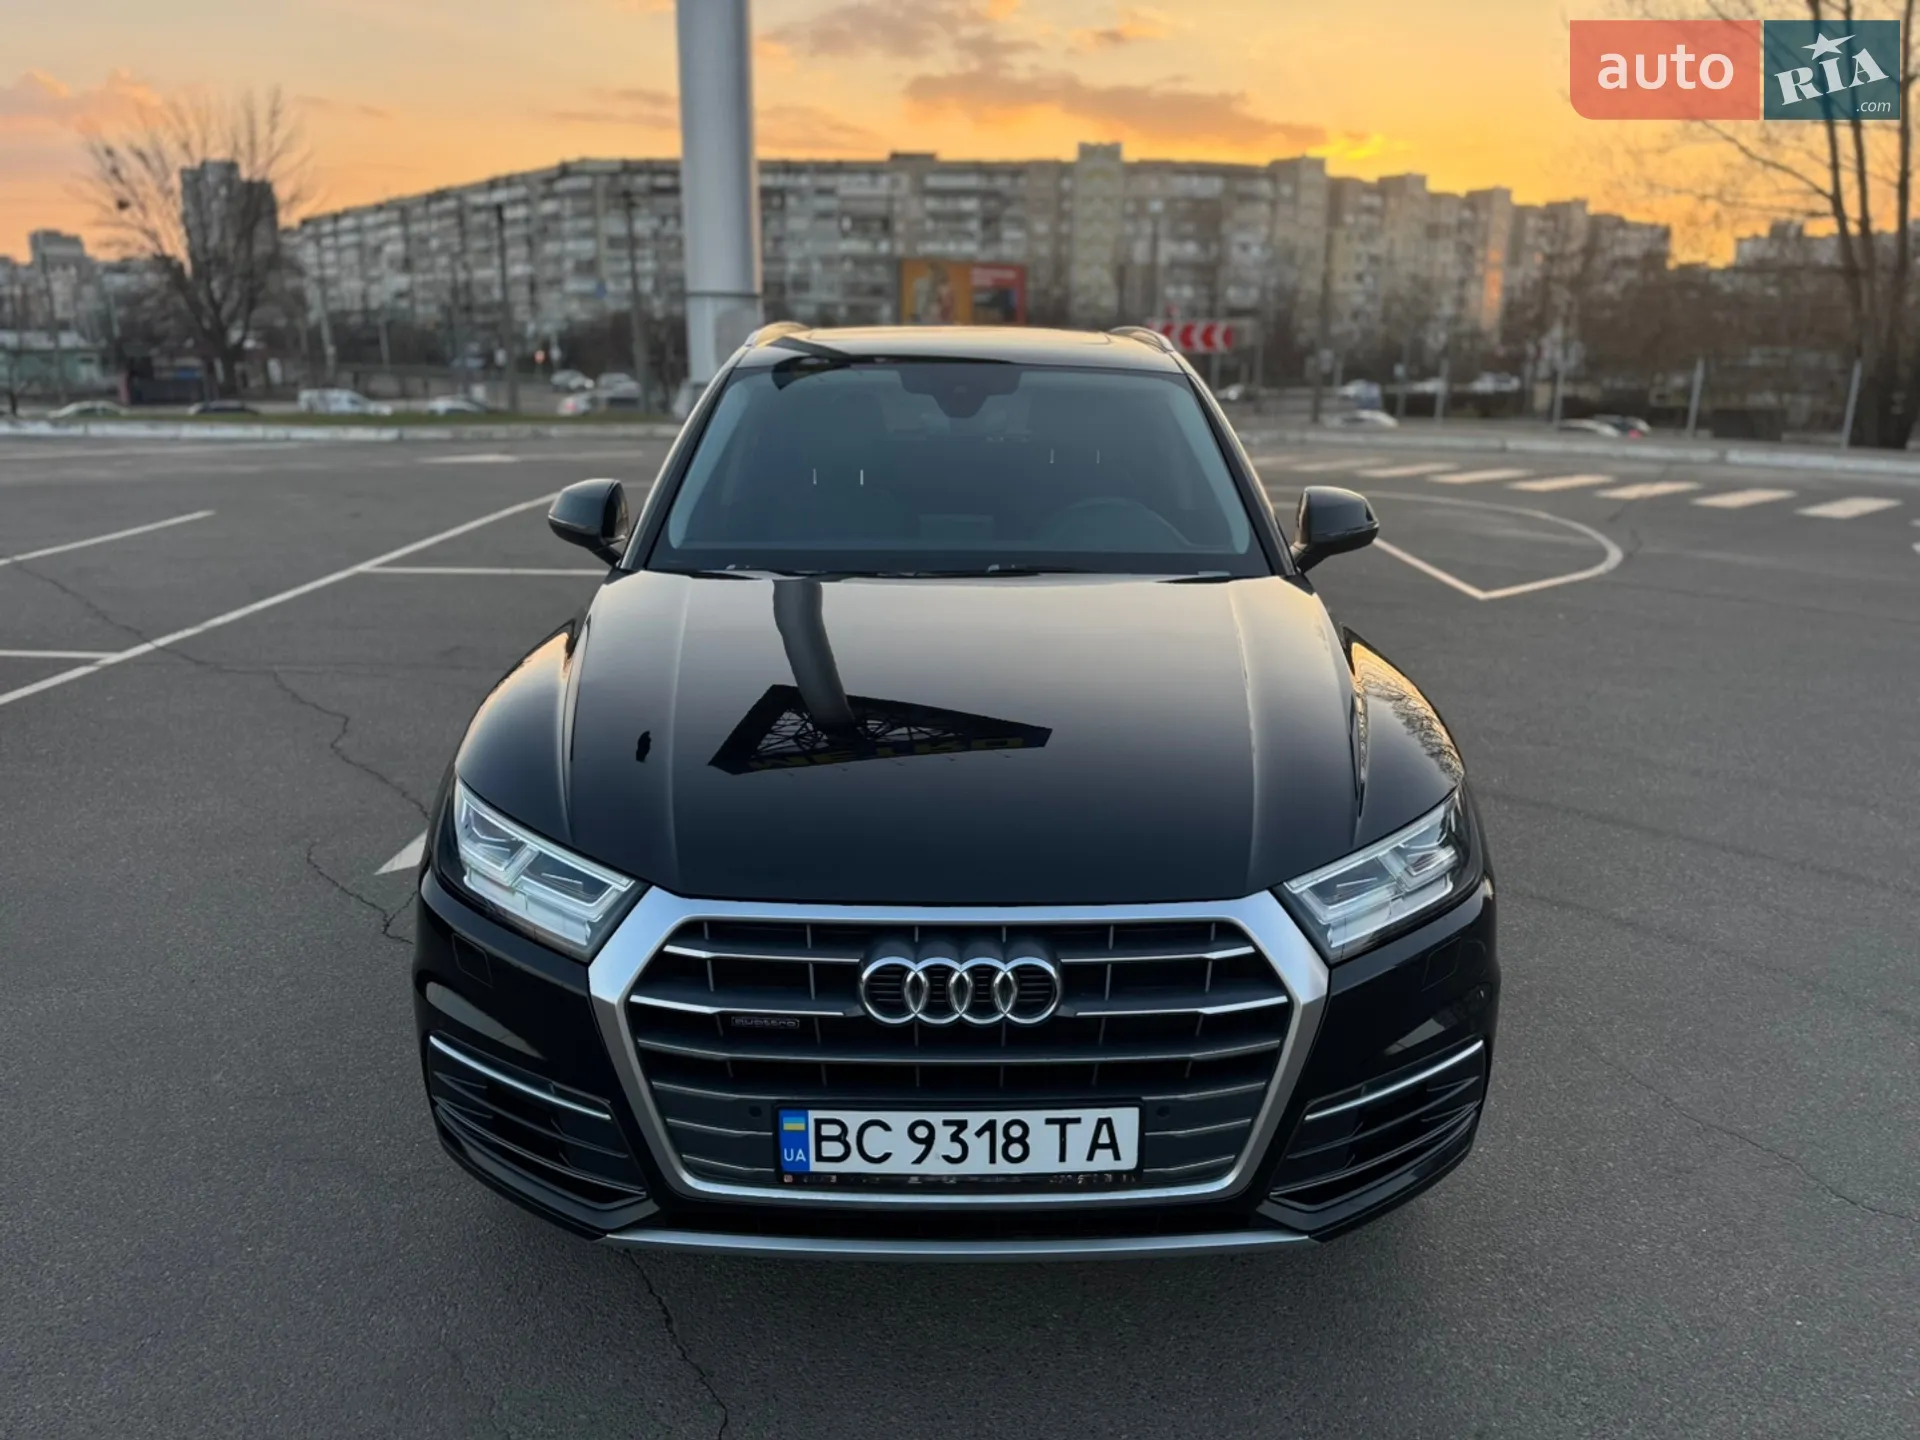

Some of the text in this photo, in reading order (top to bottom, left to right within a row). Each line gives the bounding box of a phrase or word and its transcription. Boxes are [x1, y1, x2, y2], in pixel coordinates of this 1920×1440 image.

[783, 1148, 807, 1162] UA
[814, 1117, 1121, 1165] BC 9318 TA
